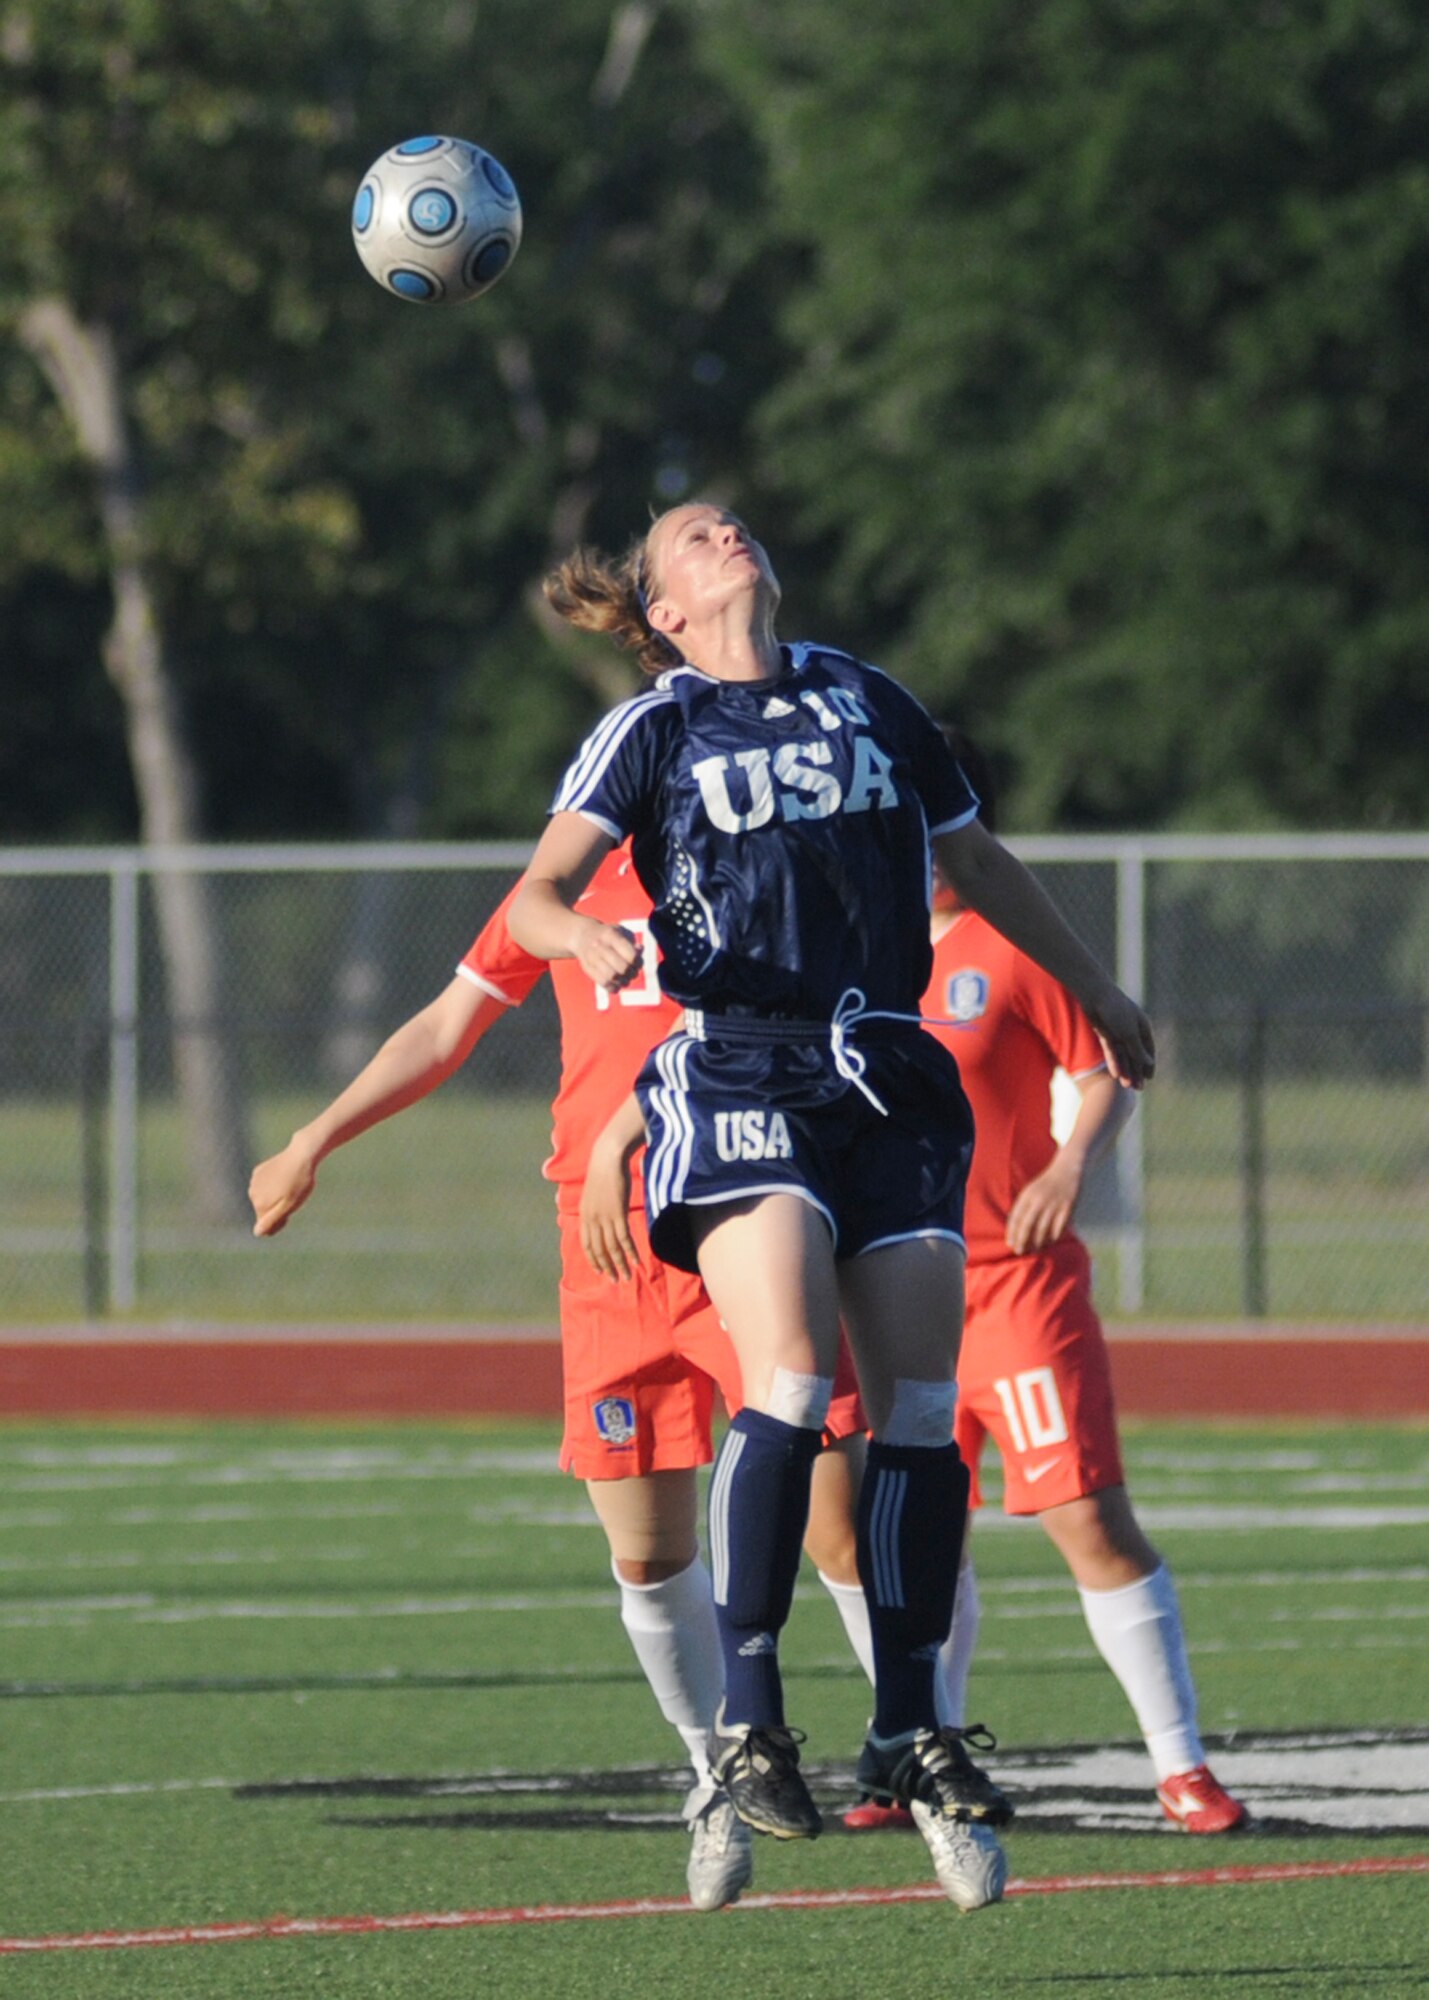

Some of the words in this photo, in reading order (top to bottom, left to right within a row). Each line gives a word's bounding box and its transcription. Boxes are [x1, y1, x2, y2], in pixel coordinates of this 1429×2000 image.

[691, 735, 899, 834] USA
[713, 1109, 794, 1163] USA
[993, 1365, 1069, 1453] 10
